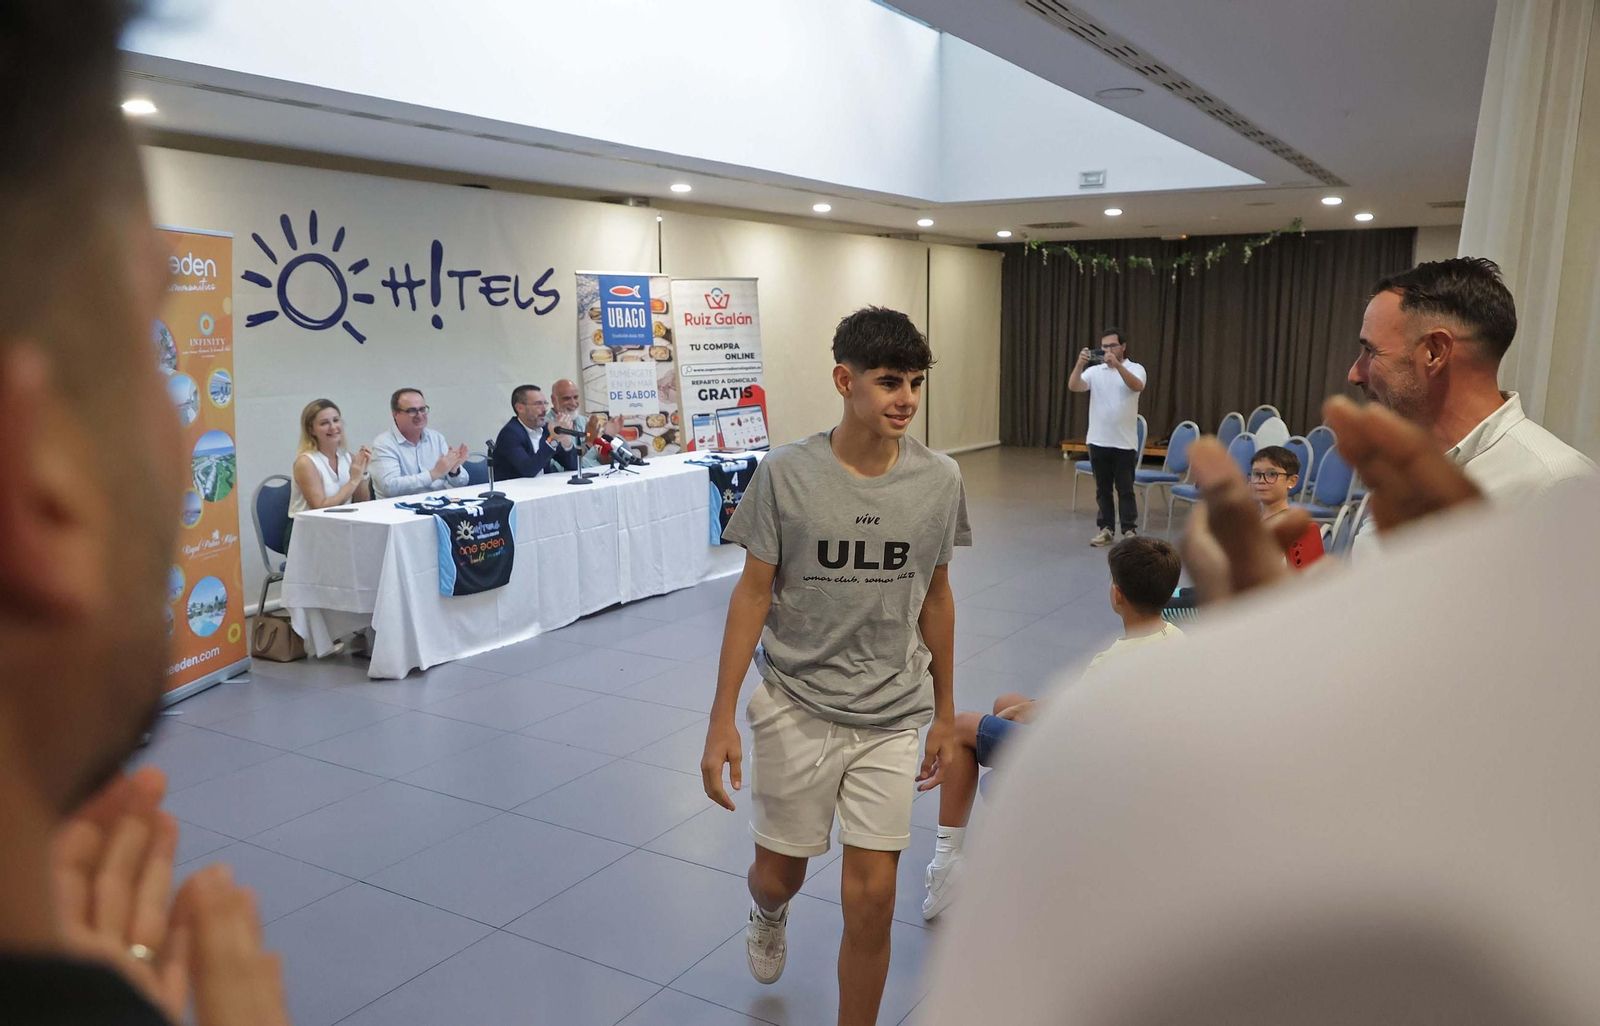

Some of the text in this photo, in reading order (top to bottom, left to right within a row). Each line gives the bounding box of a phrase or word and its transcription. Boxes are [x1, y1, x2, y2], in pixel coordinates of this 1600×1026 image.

[607, 307, 646, 328] UBAGO
[684, 312, 753, 326] Ruiz Galán
[189, 337, 226, 347] INFINITY
[689, 342, 741, 351] TU COMPRA
[725, 352, 756, 360] ONLINE
[609, 389, 657, 401] DE SABOR
[698, 386, 754, 401] GRATIS
[855, 513, 881, 525] vive
[459, 543, 478, 556] one
[480, 537, 506, 552] eden
[817, 540, 911, 570] ULB
